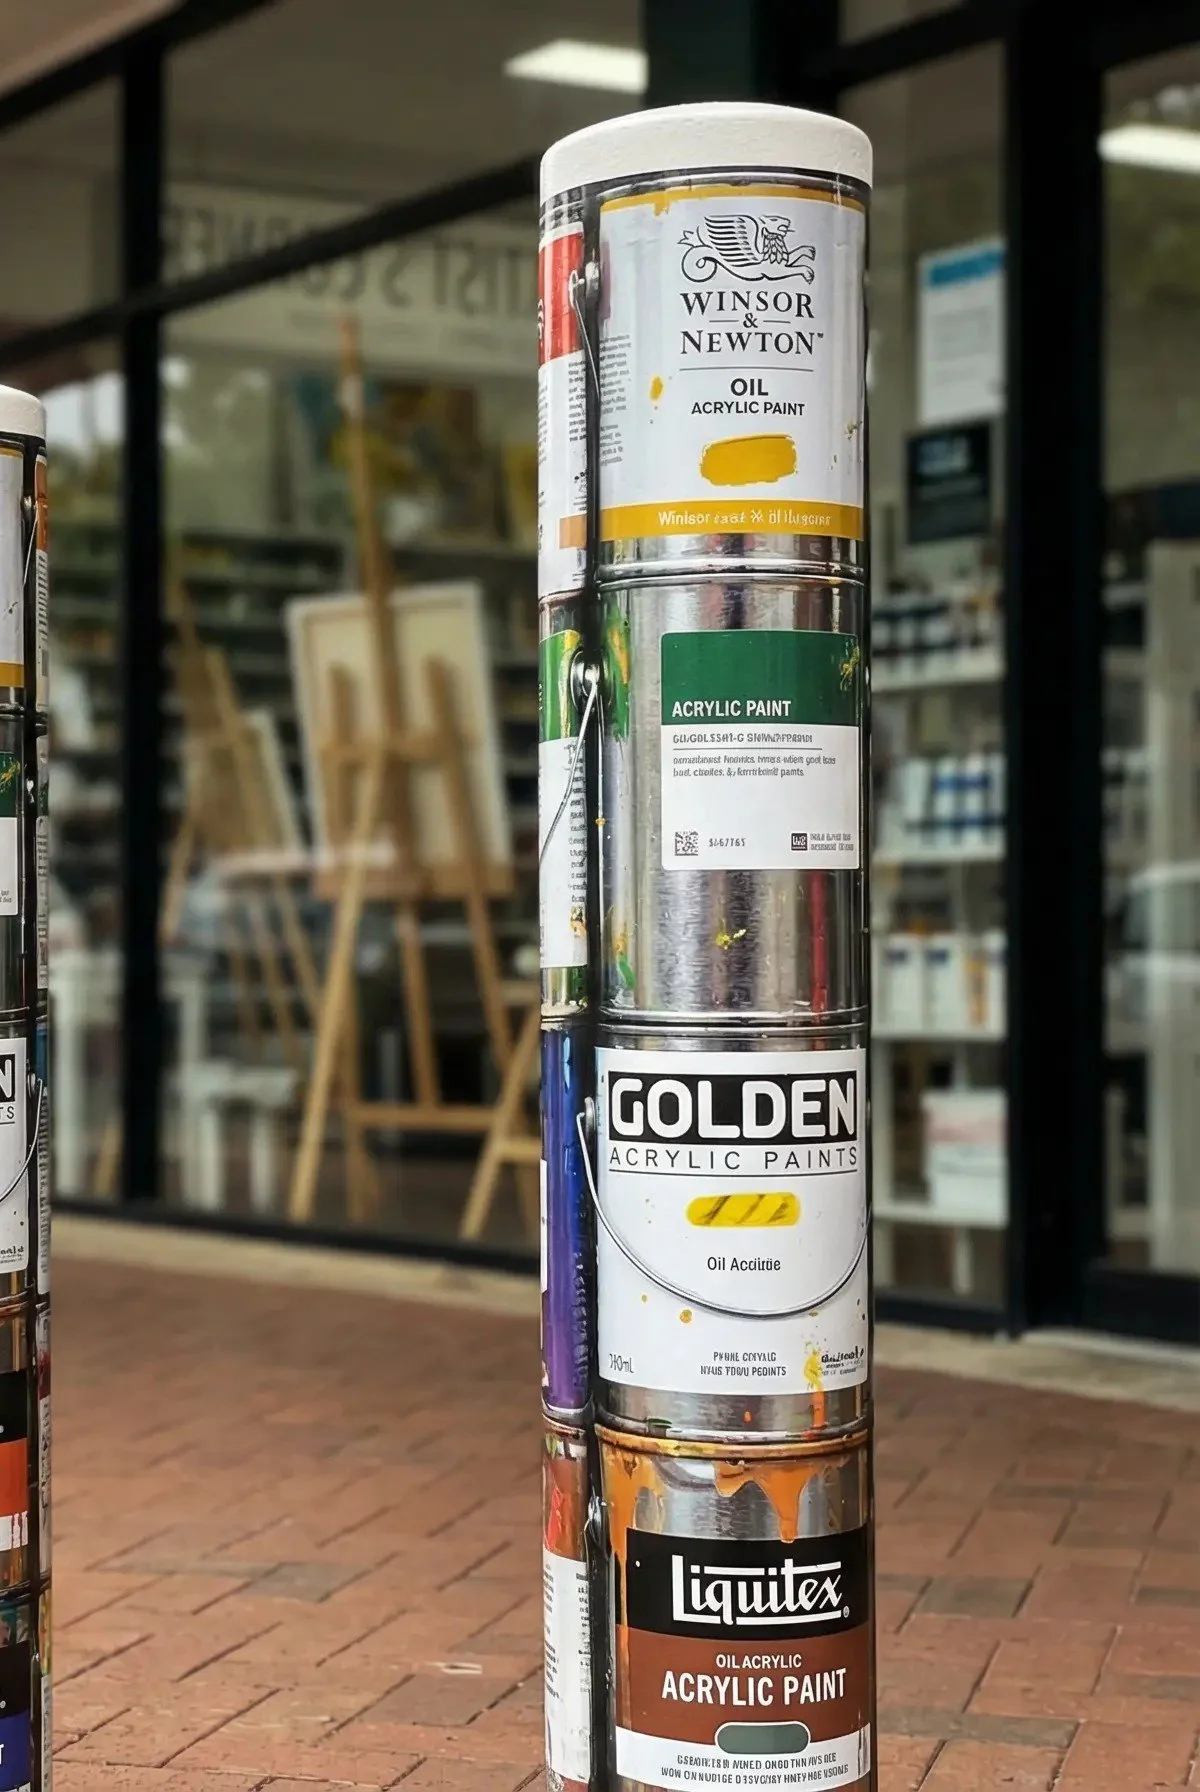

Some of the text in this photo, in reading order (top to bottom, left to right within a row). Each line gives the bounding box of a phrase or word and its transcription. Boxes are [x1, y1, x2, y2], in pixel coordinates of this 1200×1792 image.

[680, 290, 816, 319] WINSOR
[742, 312, 759, 329] &
[680, 330, 817, 355] NEWTON
[730, 378, 770, 396] OIL
[691, 401, 806, 417] ACRYLIC PAINT
[672, 701, 792, 718] ACRYLIC PAINT
[611, 1077, 855, 1139] GOLDEN
[609, 1146, 857, 1170] ACRYLIC PAINTS
[707, 1256, 726, 1271] Oil
[672, 1554, 843, 1626] Liquitex
[716, 1654, 802, 1669] OIL ACRYLIC
[662, 1667, 847, 1707] ACRYLIC PAINT
